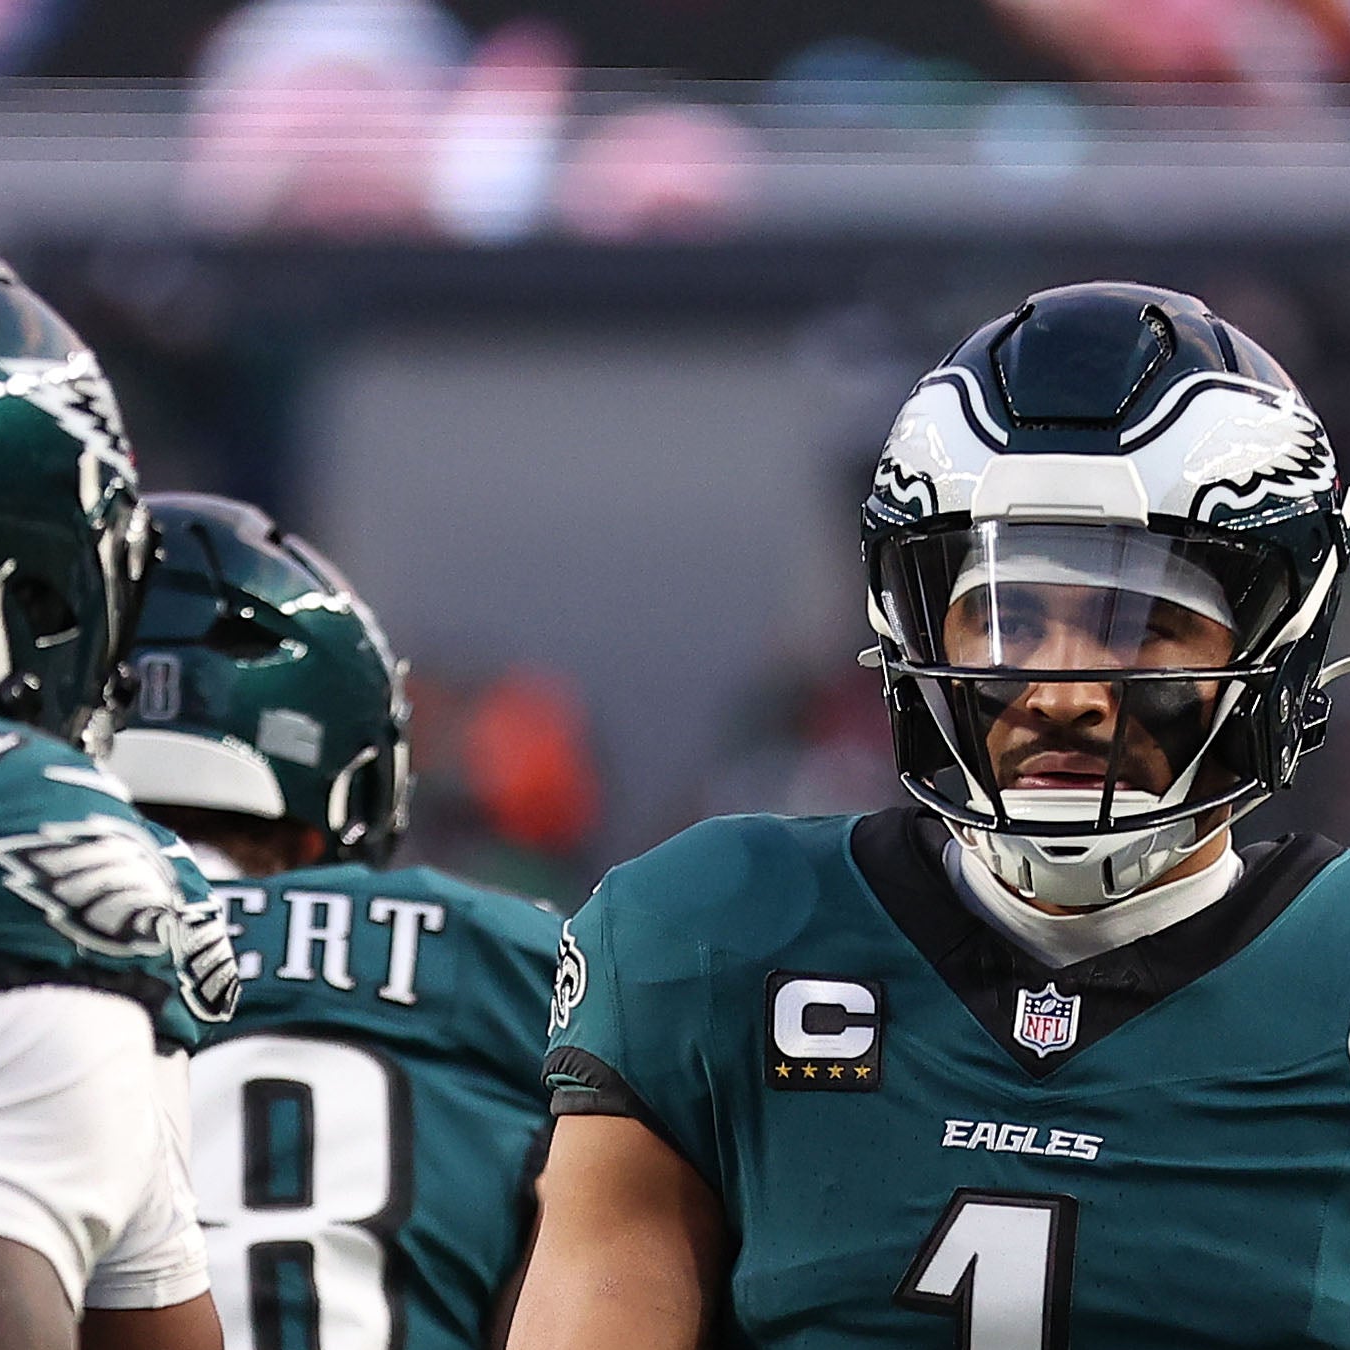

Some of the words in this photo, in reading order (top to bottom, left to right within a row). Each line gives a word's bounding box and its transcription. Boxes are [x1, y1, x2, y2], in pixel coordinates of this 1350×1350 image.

[773, 978, 877, 1059] C
[1025, 1015, 1065, 1044] NFL
[942, 1120, 1104, 1161] EAGLES
